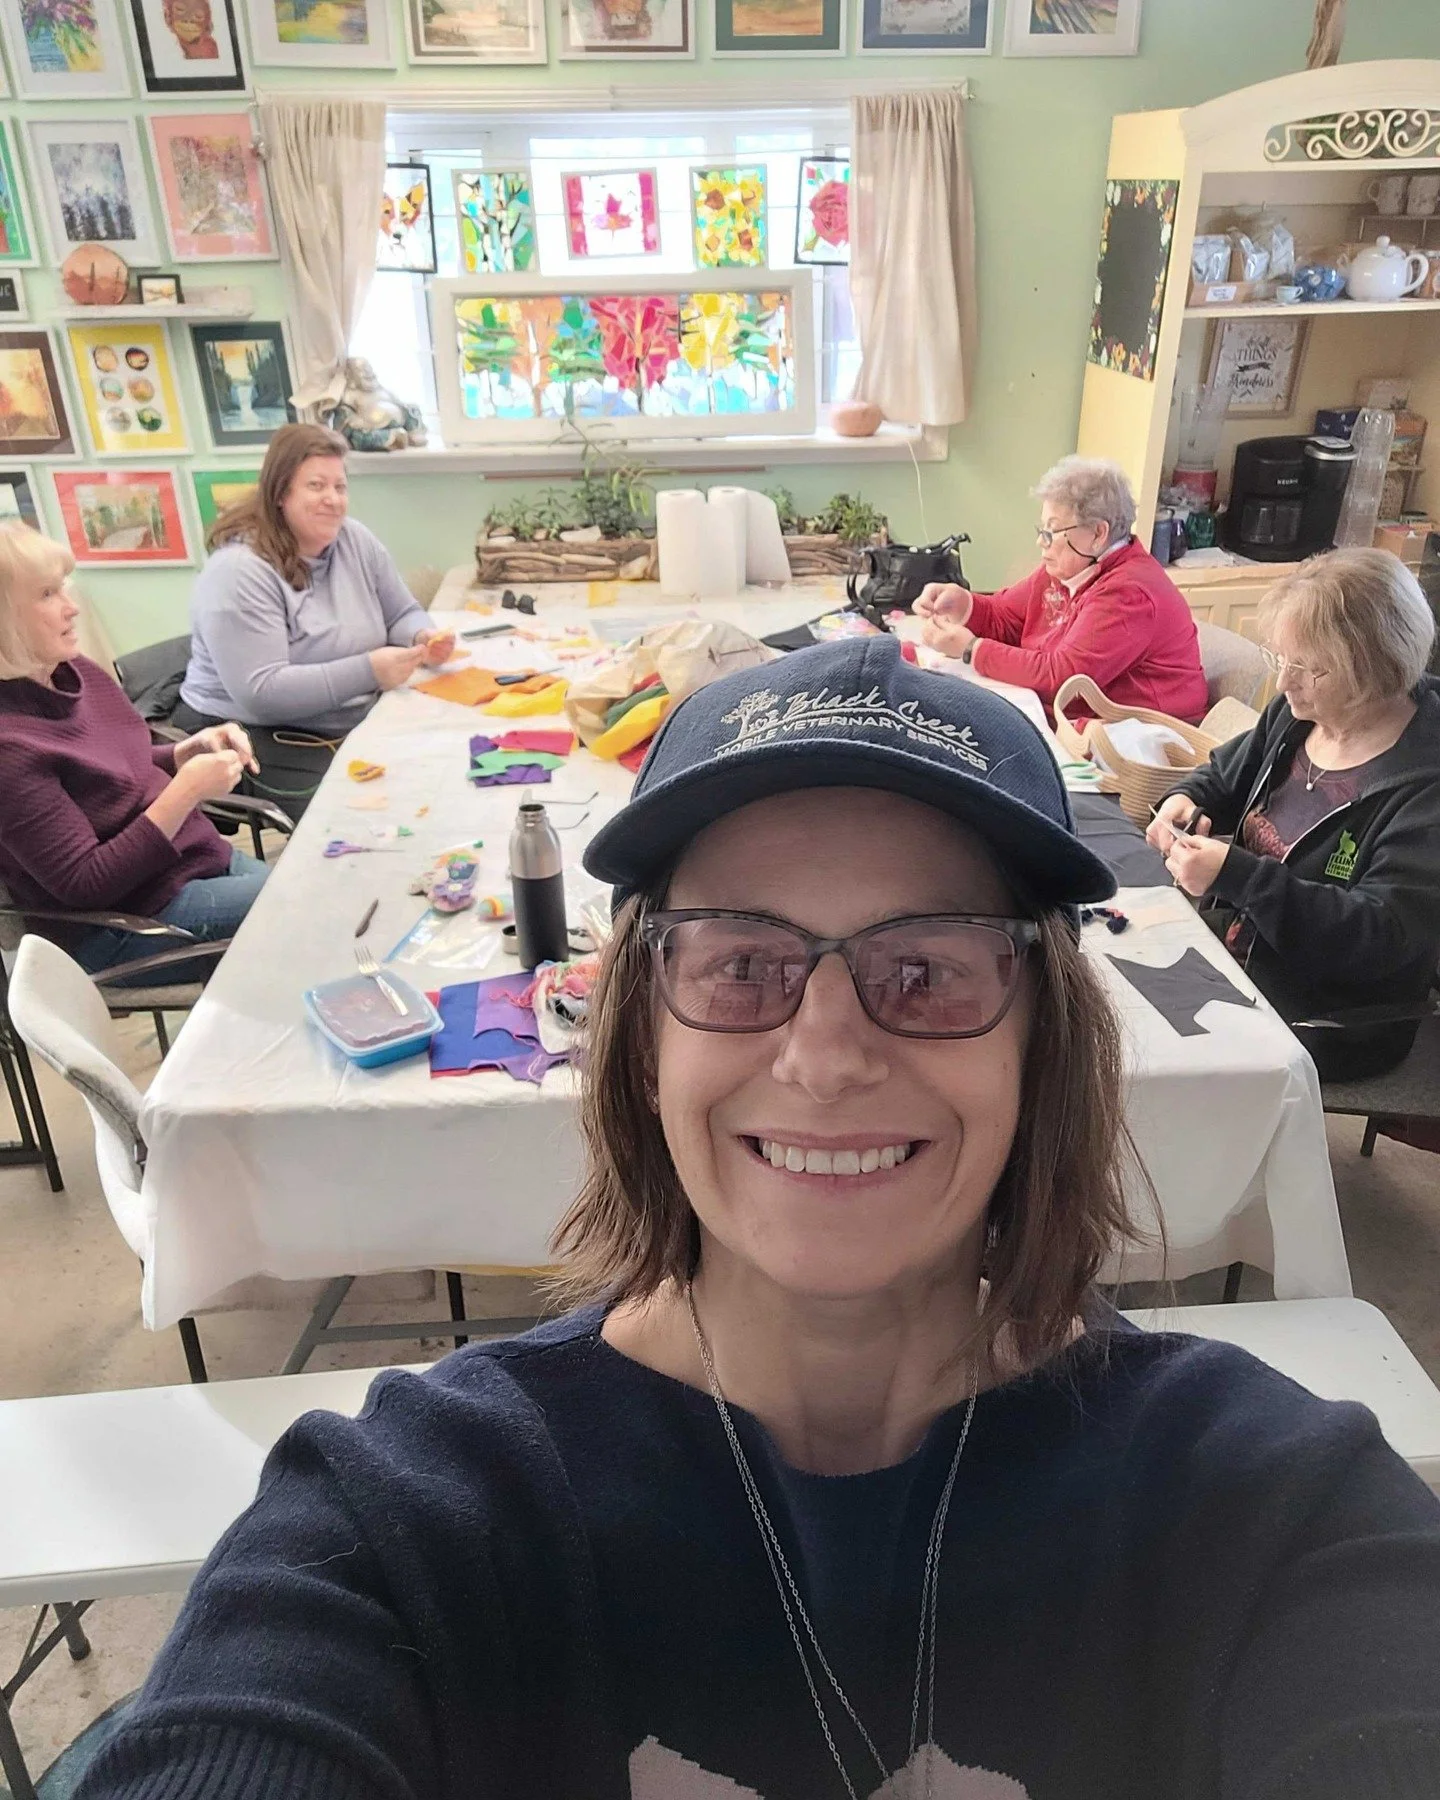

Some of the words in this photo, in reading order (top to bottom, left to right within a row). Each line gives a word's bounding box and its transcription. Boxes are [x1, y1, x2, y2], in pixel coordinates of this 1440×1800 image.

[716, 728, 778, 759] MOBILE
[782, 715, 904, 733] VETERINARY
[906, 728, 988, 771] SERVICES
[782, 685, 887, 720] Black
[898, 700, 979, 747] Creek
